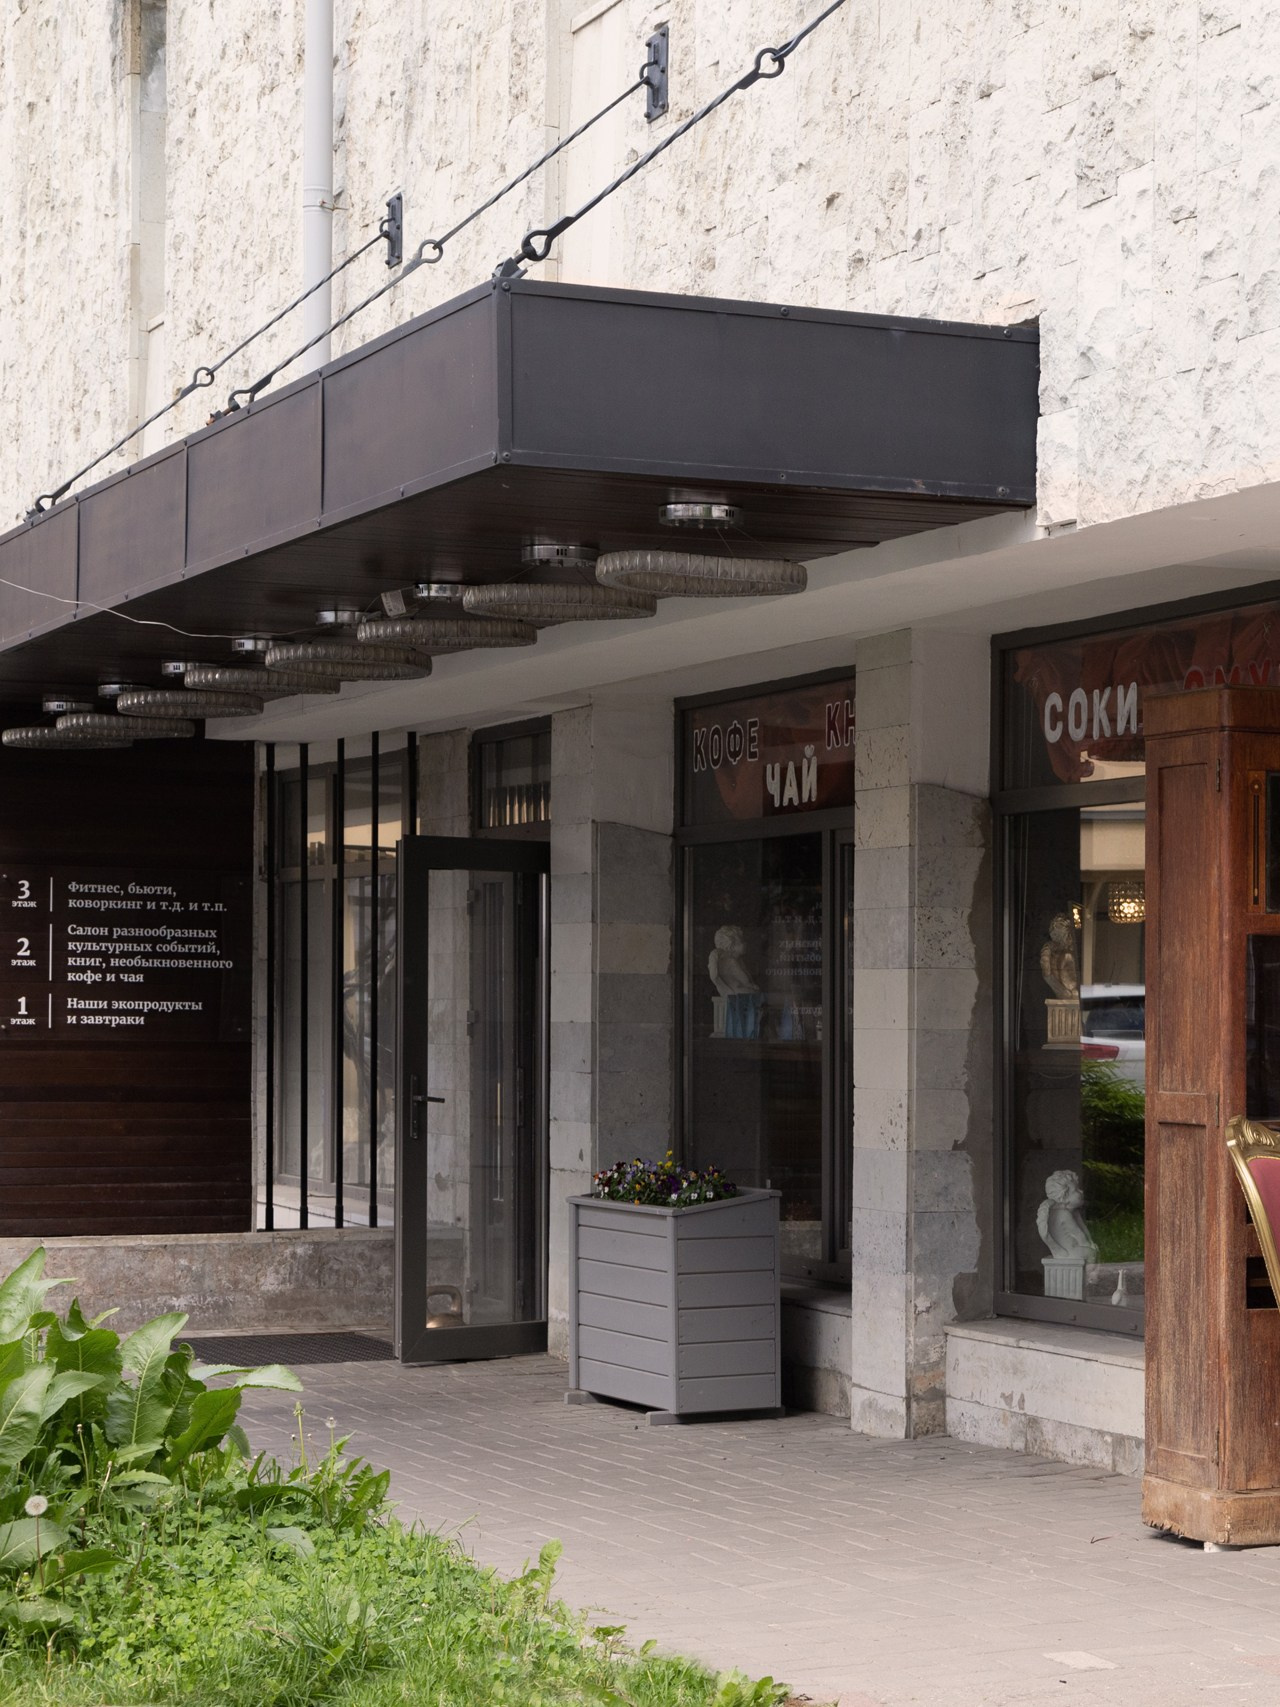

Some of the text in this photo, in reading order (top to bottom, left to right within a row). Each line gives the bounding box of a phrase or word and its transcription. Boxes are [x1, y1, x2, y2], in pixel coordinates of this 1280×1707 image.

[1044, 681, 1138, 743] СОКИ
[693, 717, 760, 773] КОФЕ
[766, 744, 818, 808] ЧАЙ
[17, 880, 31, 899] 3
[68, 881, 177, 898] Фитнес, бьюти,
[12, 900, 37, 908] этаж
[68, 897, 228, 913] коворкинг и т.д. и т.п.
[67, 924, 217, 939] Салон разнообразных
[16, 938, 31, 956] 2
[67, 942, 221, 956] культурных событий,
[11, 958, 36, 967] этаж
[67, 956, 233, 970] книг, необыкновенного
[67, 971, 144, 984] кофе и чая
[17, 997, 28, 1015] 1
[67, 998, 203, 1013] Наши экопродукты
[10, 1016, 36, 1026] этаж
[67, 1015, 145, 1026] и завтраки
